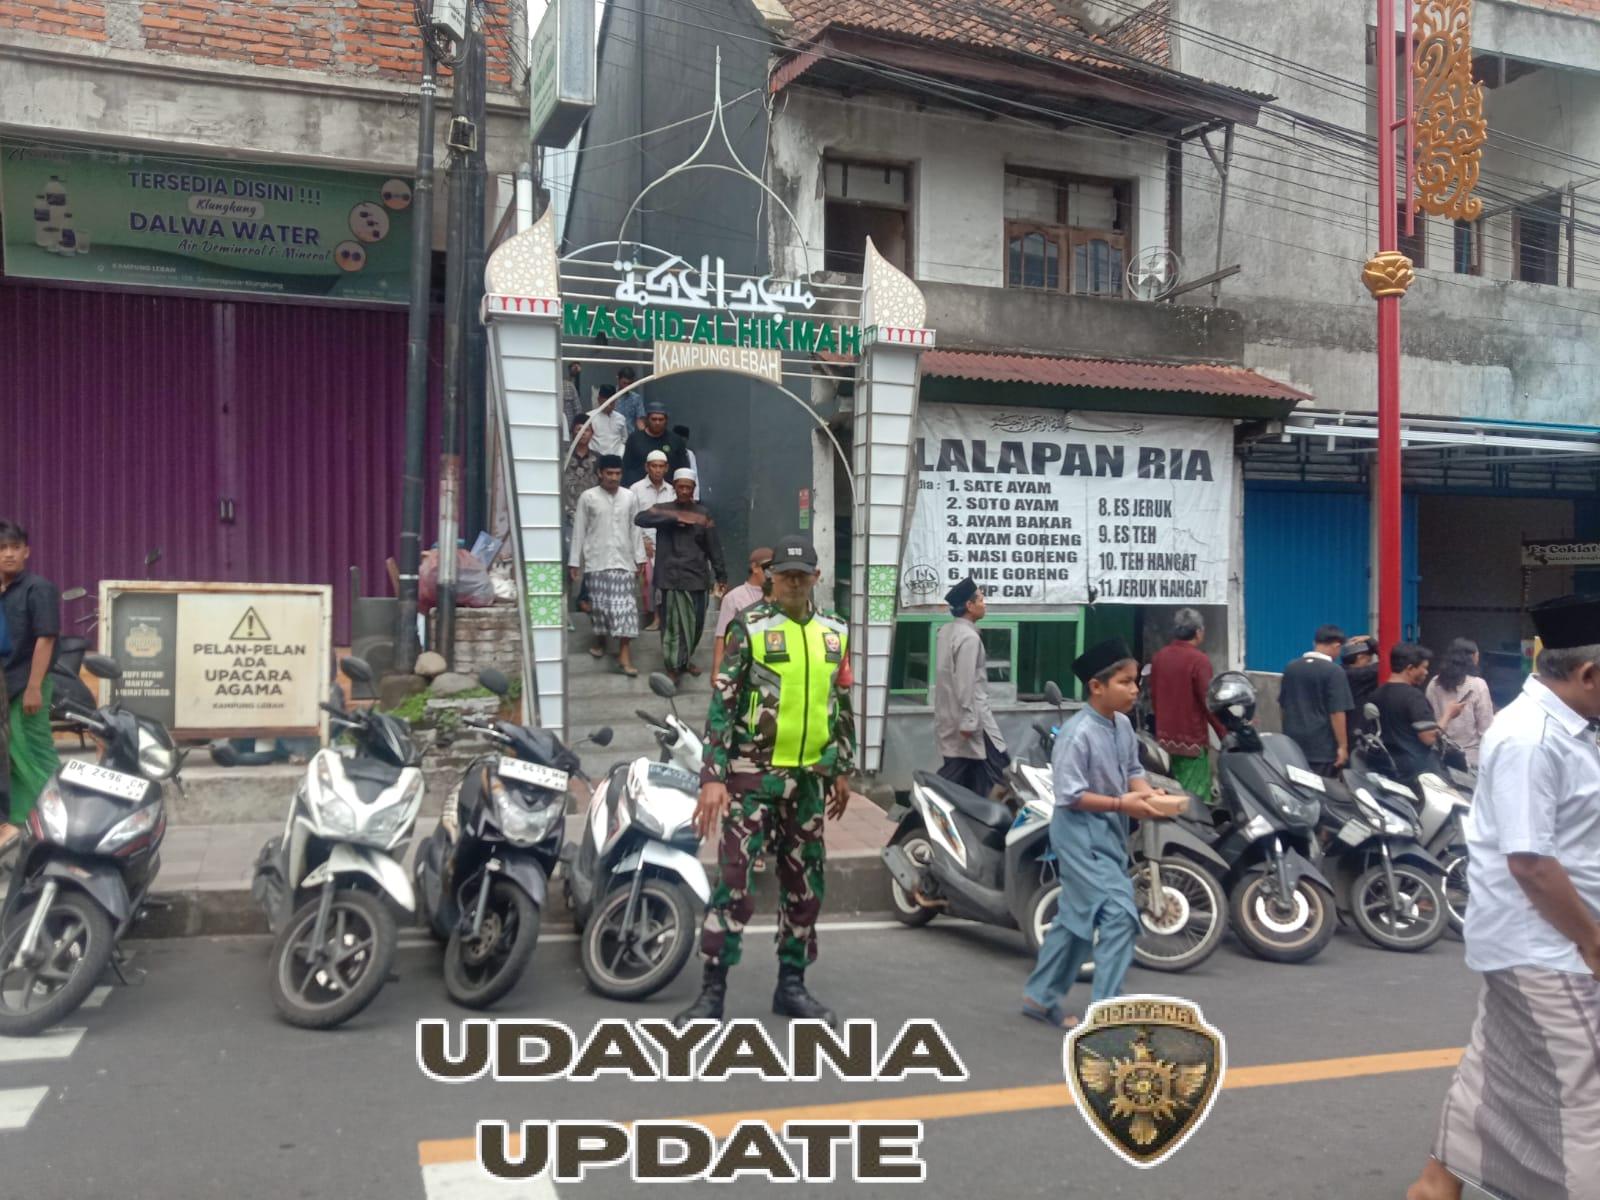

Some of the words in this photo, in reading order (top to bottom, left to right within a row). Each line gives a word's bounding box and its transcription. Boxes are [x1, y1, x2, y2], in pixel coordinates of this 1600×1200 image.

[128, 172, 228, 195] TERSEDIA
[233, 179, 294, 202] DISINI
[196, 199, 258, 217] Klungkung
[130, 212, 225, 237] DALWA
[232, 221, 320, 246] WATER
[178, 239, 196, 251] Air
[283, 247, 332, 261] Mineral
[613, 255, 725, 309] الحكمة
[728, 274, 816, 324] مسجد
[563, 303, 686, 342] MASJID
[690, 313, 735, 346] AL
[737, 316, 863, 357] HIKMAH
[659, 343, 730, 373] KAMPUNG
[732, 350, 778, 379] LEBAH
[916, 437, 1125, 479] LALAPAN
[1137, 446, 1214, 482] RIA
[946, 479, 960, 492] 1.
[963, 480, 1003, 493] SATE
[1006, 481, 1052, 495] AYAM
[946, 497, 962, 510] 2.
[966, 497, 1011, 511] SOTO
[1014, 499, 1059, 512] AYAM
[1098, 497, 1111, 517] 8.
[1114, 498, 1129, 517] ES
[1132, 499, 1173, 518] JERUK
[946, 514, 963, 528] 3.
[966, 515, 1012, 528] AYAM
[1016, 516, 1072, 529] BAKAR
[946, 532, 963, 545] 4.
[966, 532, 1012, 546] AYAM
[1015, 533, 1082, 546] GORENG
[1098, 525, 1111, 544] 9.
[1114, 525, 1129, 544] ES
[1132, 525, 1157, 544] TEH
[947, 550, 963, 563] 5.
[968, 550, 1007, 563] NASI
[1011, 550, 1078, 563] GORENG
[1098, 552, 1117, 571] 10.
[1120, 552, 1144, 571] TEH
[1147, 553, 1198, 571] HANGAT
[948, 567, 964, 580] 6.
[968, 567, 999, 580] MIE
[1003, 568, 1070, 581] GORENG
[1003, 585, 1034, 597] CAY
[1117, 579, 1157, 598] JERUK
[1160, 580, 1208, 598] HANGAT
[193, 643, 306, 655] PELAN-PELAN
[232, 657, 267, 668] ADA
[205, 670, 292, 682] UPACARA
[215, 684, 283, 696] AGAMA
[69, 761, 86, 772] DK
